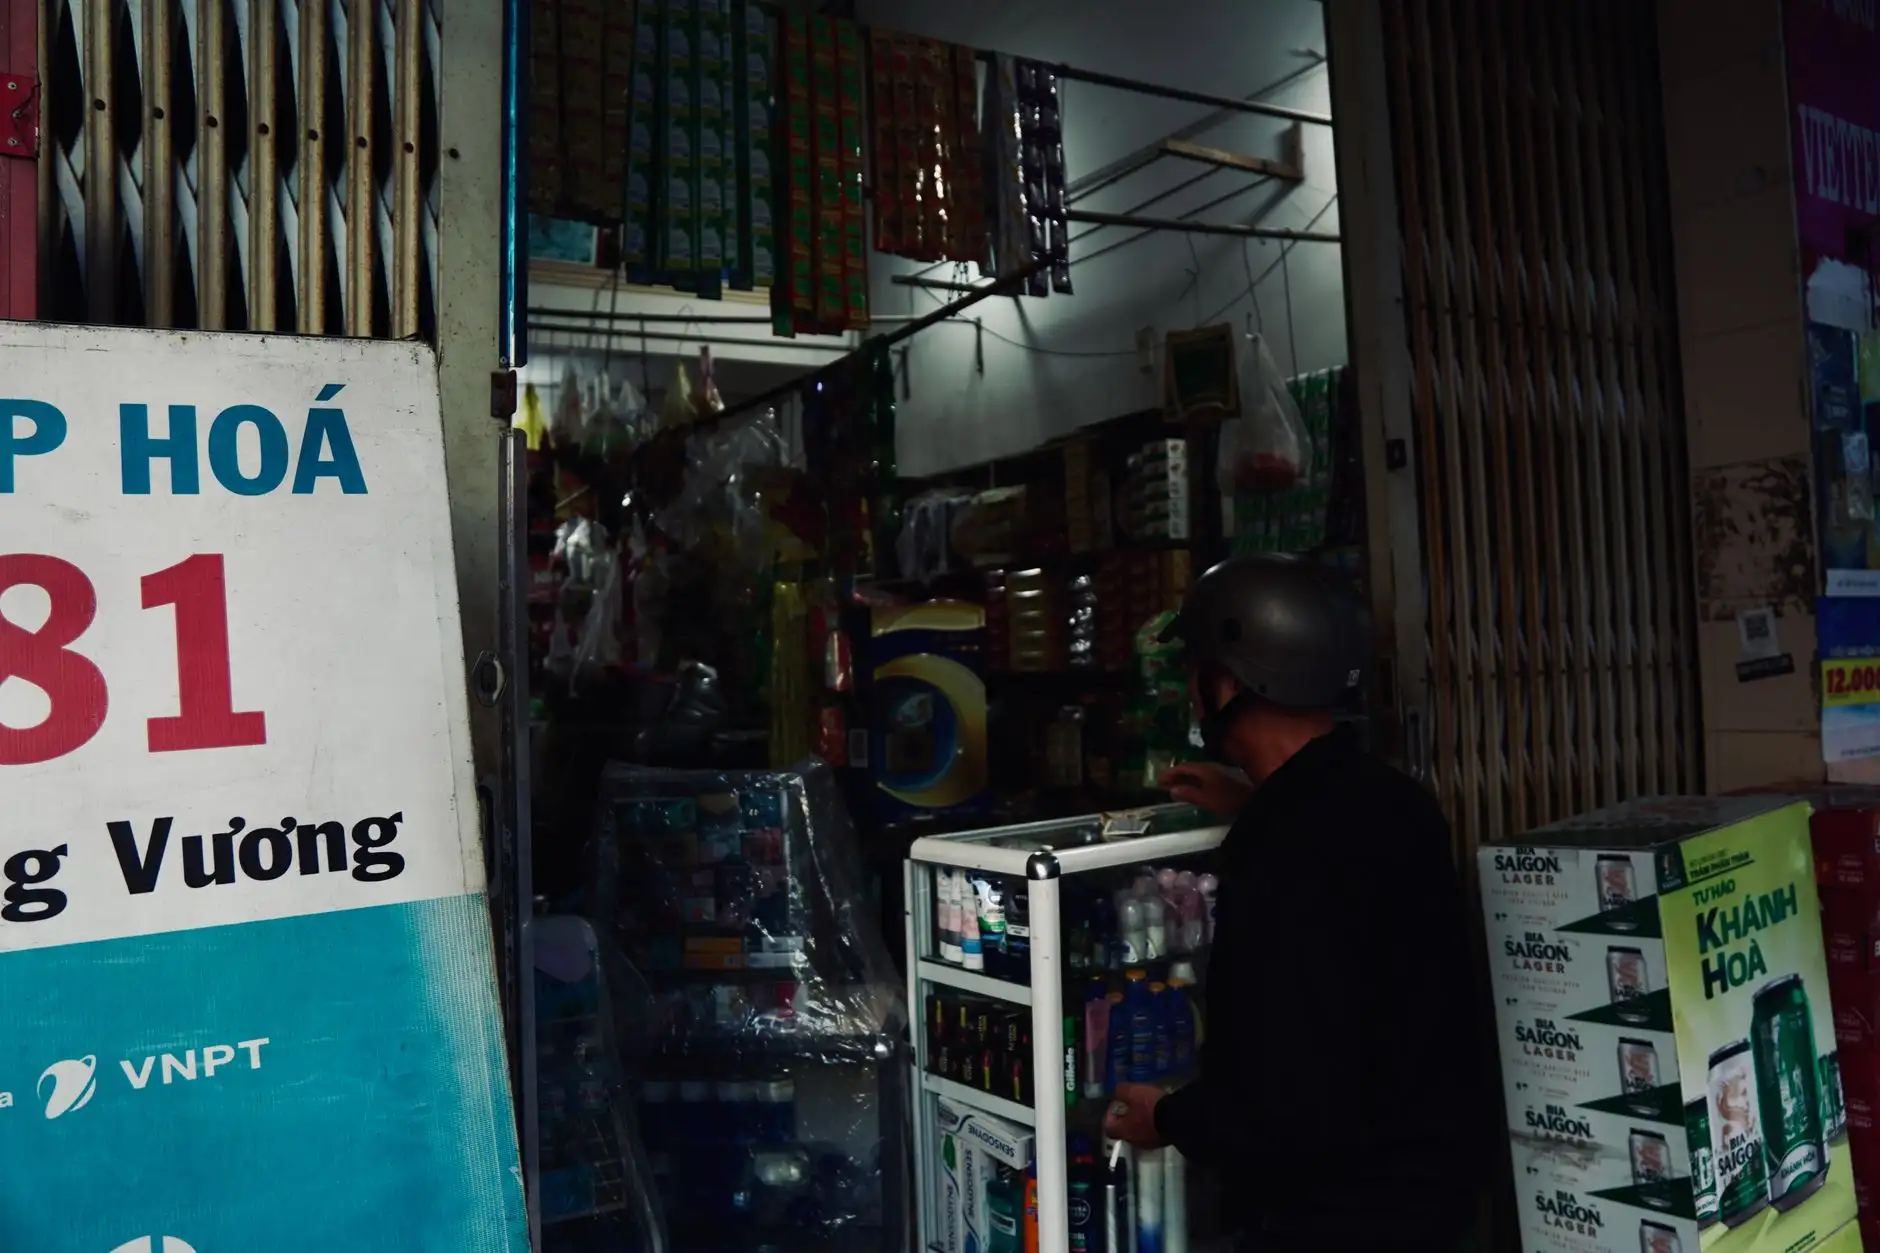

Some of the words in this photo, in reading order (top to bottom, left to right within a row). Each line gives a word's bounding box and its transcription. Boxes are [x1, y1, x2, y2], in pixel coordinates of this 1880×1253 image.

[1798, 102, 1880, 216] VIETTE
[0, 398, 68, 494] P
[120, 383, 368, 495] HOÁ
[0, 553, 264, 766] 81
[0, 843, 68, 922] g
[106, 811, 406, 895] Vương
[1494, 855, 1560, 873] SAIGON
[1502, 873, 1555, 886] LAGER
[1697, 882, 1798, 955] KHÁNH
[1524, 932, 1545, 944] BIA
[1504, 940, 1570, 962] SAIGON
[1513, 958, 1566, 974] LAGER
[1701, 938, 1768, 1000] HOÀ
[1534, 1018, 1556, 1031] BIA
[1515, 1026, 1581, 1050] SAIGON
[119, 1037, 270, 1090] VNPT
[1523, 1044, 1577, 1062] LAGER
[1545, 1104, 1567, 1118] BIA
[1524, 1110, 1591, 1138] SAIGON
[967, 1122, 1017, 1159] SENSODYNE
[1729, 1133, 1747, 1150] BIA
[1718, 1136, 1764, 1177] SAIGON
[1556, 1190, 1577, 1205] BIA
[1535, 1195, 1602, 1227] SAIGON
[1543, 1214, 1597, 1238] LAGER
